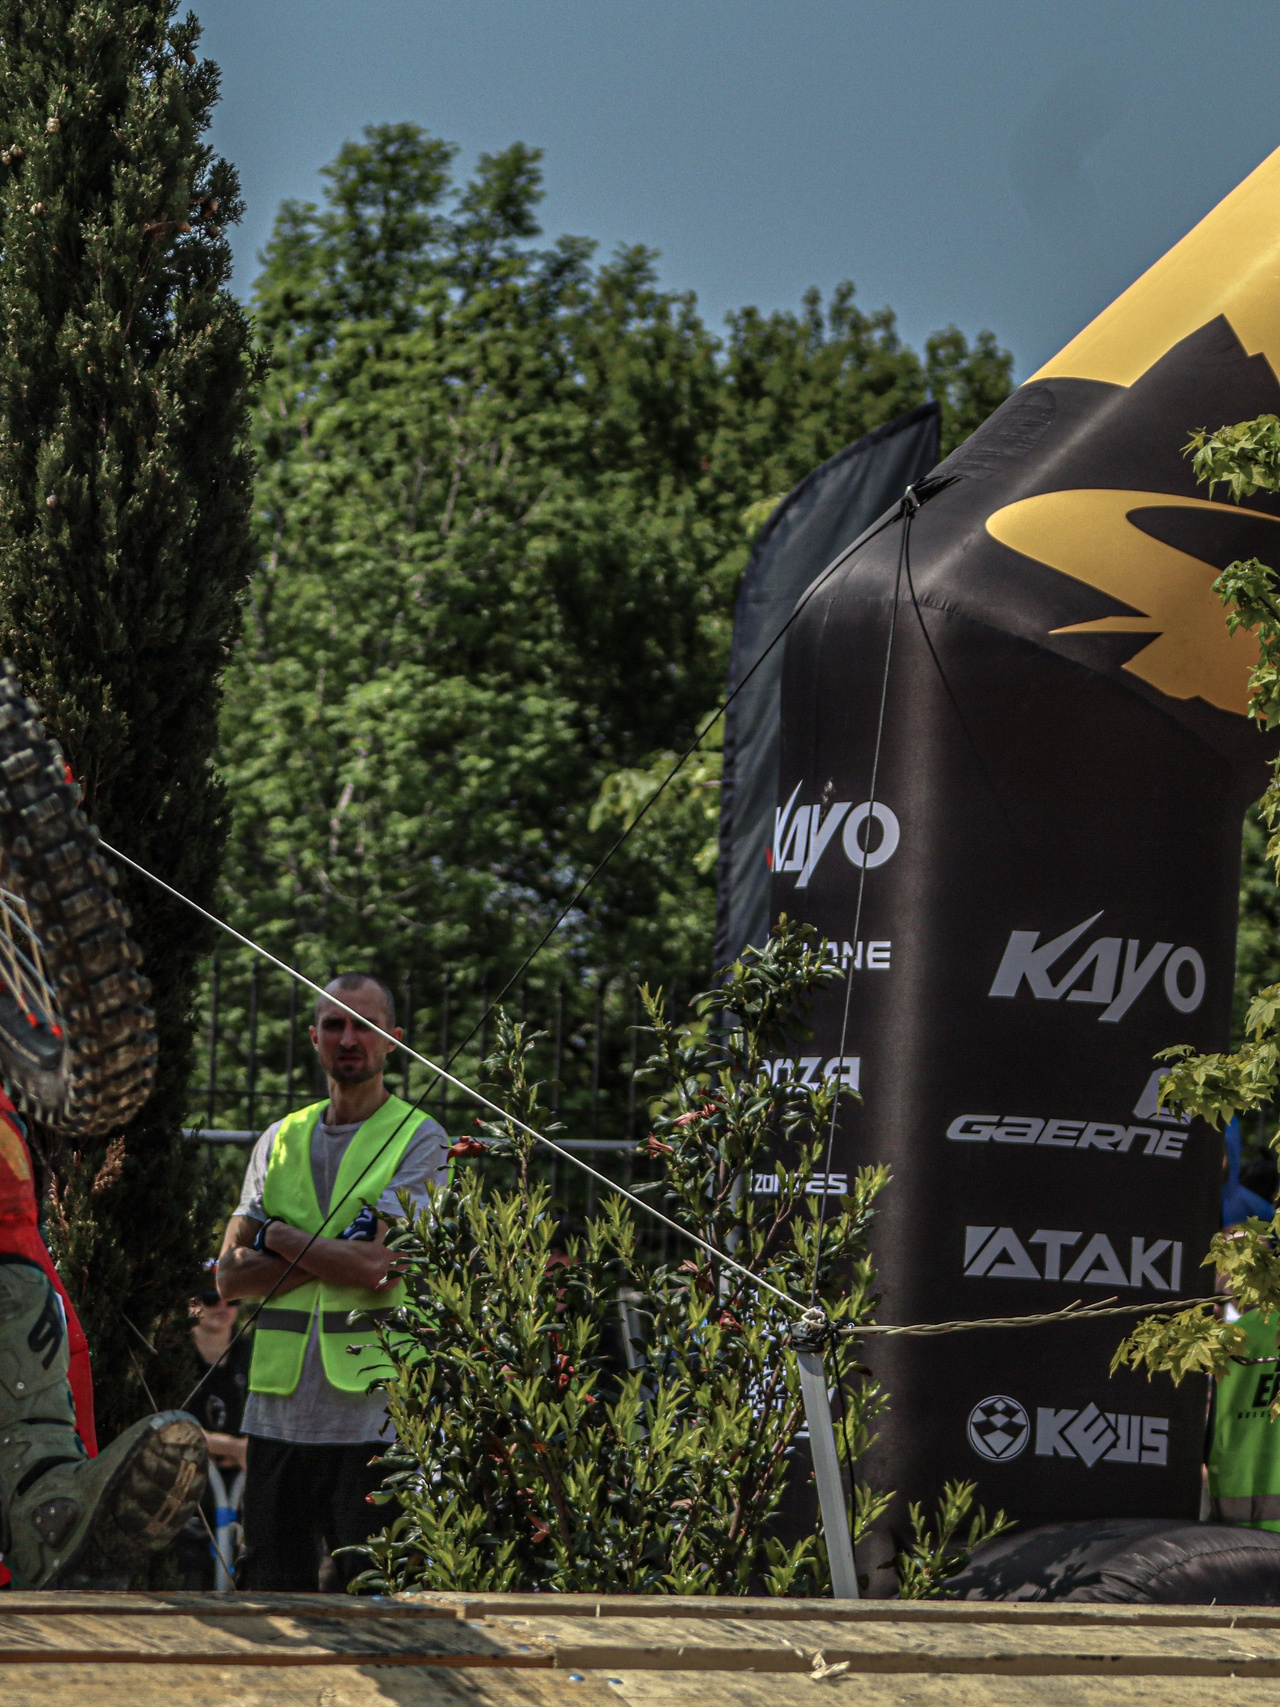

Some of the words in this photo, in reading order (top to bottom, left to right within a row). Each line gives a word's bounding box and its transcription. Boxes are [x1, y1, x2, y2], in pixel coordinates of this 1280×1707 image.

[988, 910, 1206, 1023] KAYO
[946, 1114, 1189, 1159] GAERNE
[964, 1225, 1183, 1292] ATAKI
